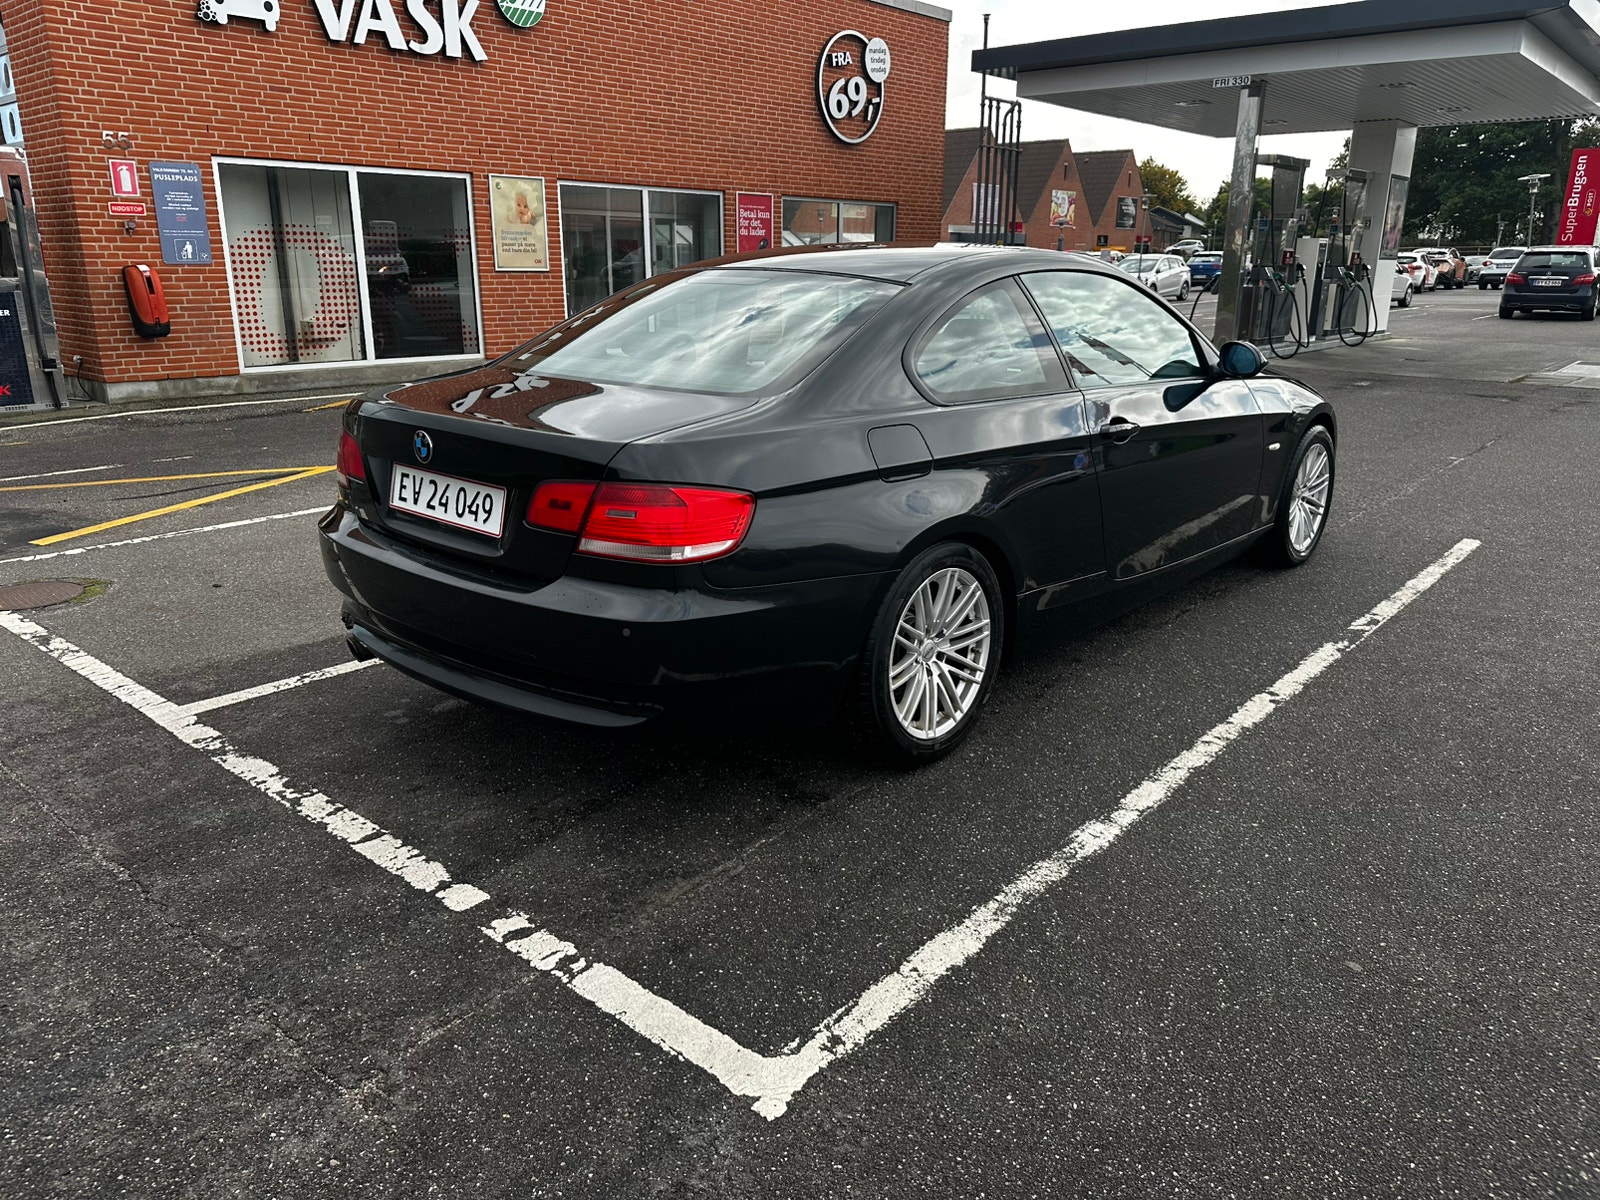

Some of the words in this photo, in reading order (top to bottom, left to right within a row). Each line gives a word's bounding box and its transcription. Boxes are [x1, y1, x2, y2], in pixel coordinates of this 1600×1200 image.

[314, 0, 489, 61] VASK
[868, 46, 887, 56] mandag
[832, 51, 853, 67] FRA
[870, 56, 886, 65] tirsdag
[870, 66, 887, 75] onsdag
[1214, 78, 1230, 88] FRI
[1232, 76, 1250, 86] 330
[102, 130, 131, 150] 55
[1561, 155, 1588, 242] SuperBrugsen
[111, 205, 143, 213] NØDSTOP
[739, 208, 757, 218] Betal
[757, 209, 770, 219] kun
[739, 218, 750, 227] for
[750, 218, 763, 228] det,
[739, 226, 748, 236] du
[749, 227, 766, 236] lader
[398, 471, 424, 506] EV
[426, 478, 451, 514] 24
[455, 486, 494, 525] 049
